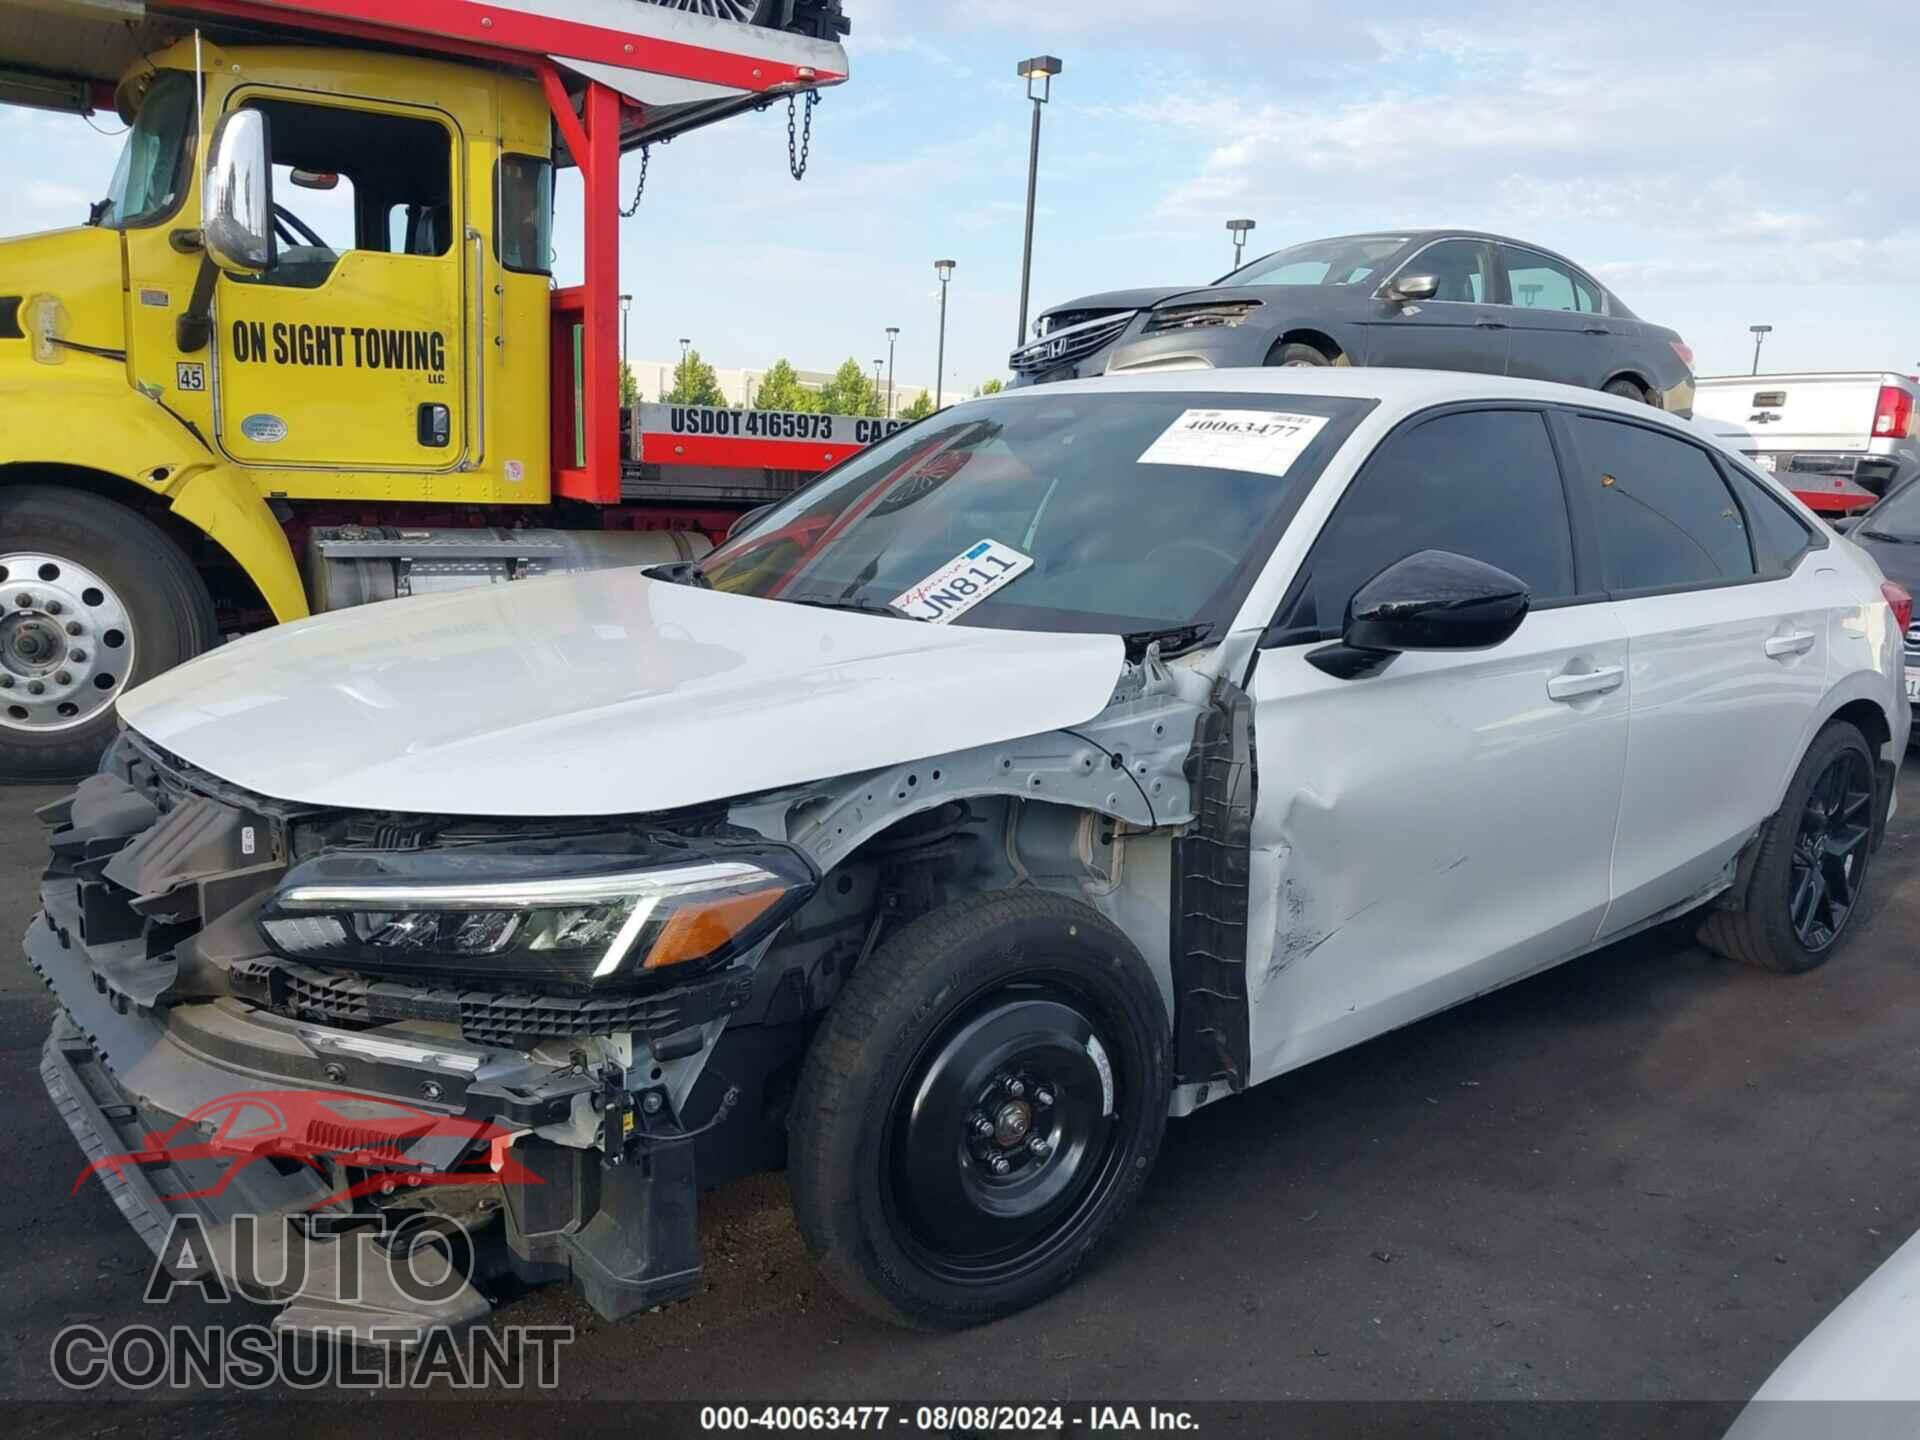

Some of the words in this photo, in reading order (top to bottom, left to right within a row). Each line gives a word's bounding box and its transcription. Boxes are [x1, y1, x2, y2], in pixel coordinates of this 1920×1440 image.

[232, 319, 267, 363] ON
[272, 322, 345, 366] SIGHT
[351, 327, 445, 371] TOWING
[180, 370, 201, 388] 45
[670, 408, 743, 433] USDOT
[745, 413, 833, 439] 4165973
[1184, 419, 1302, 438] 40063477
